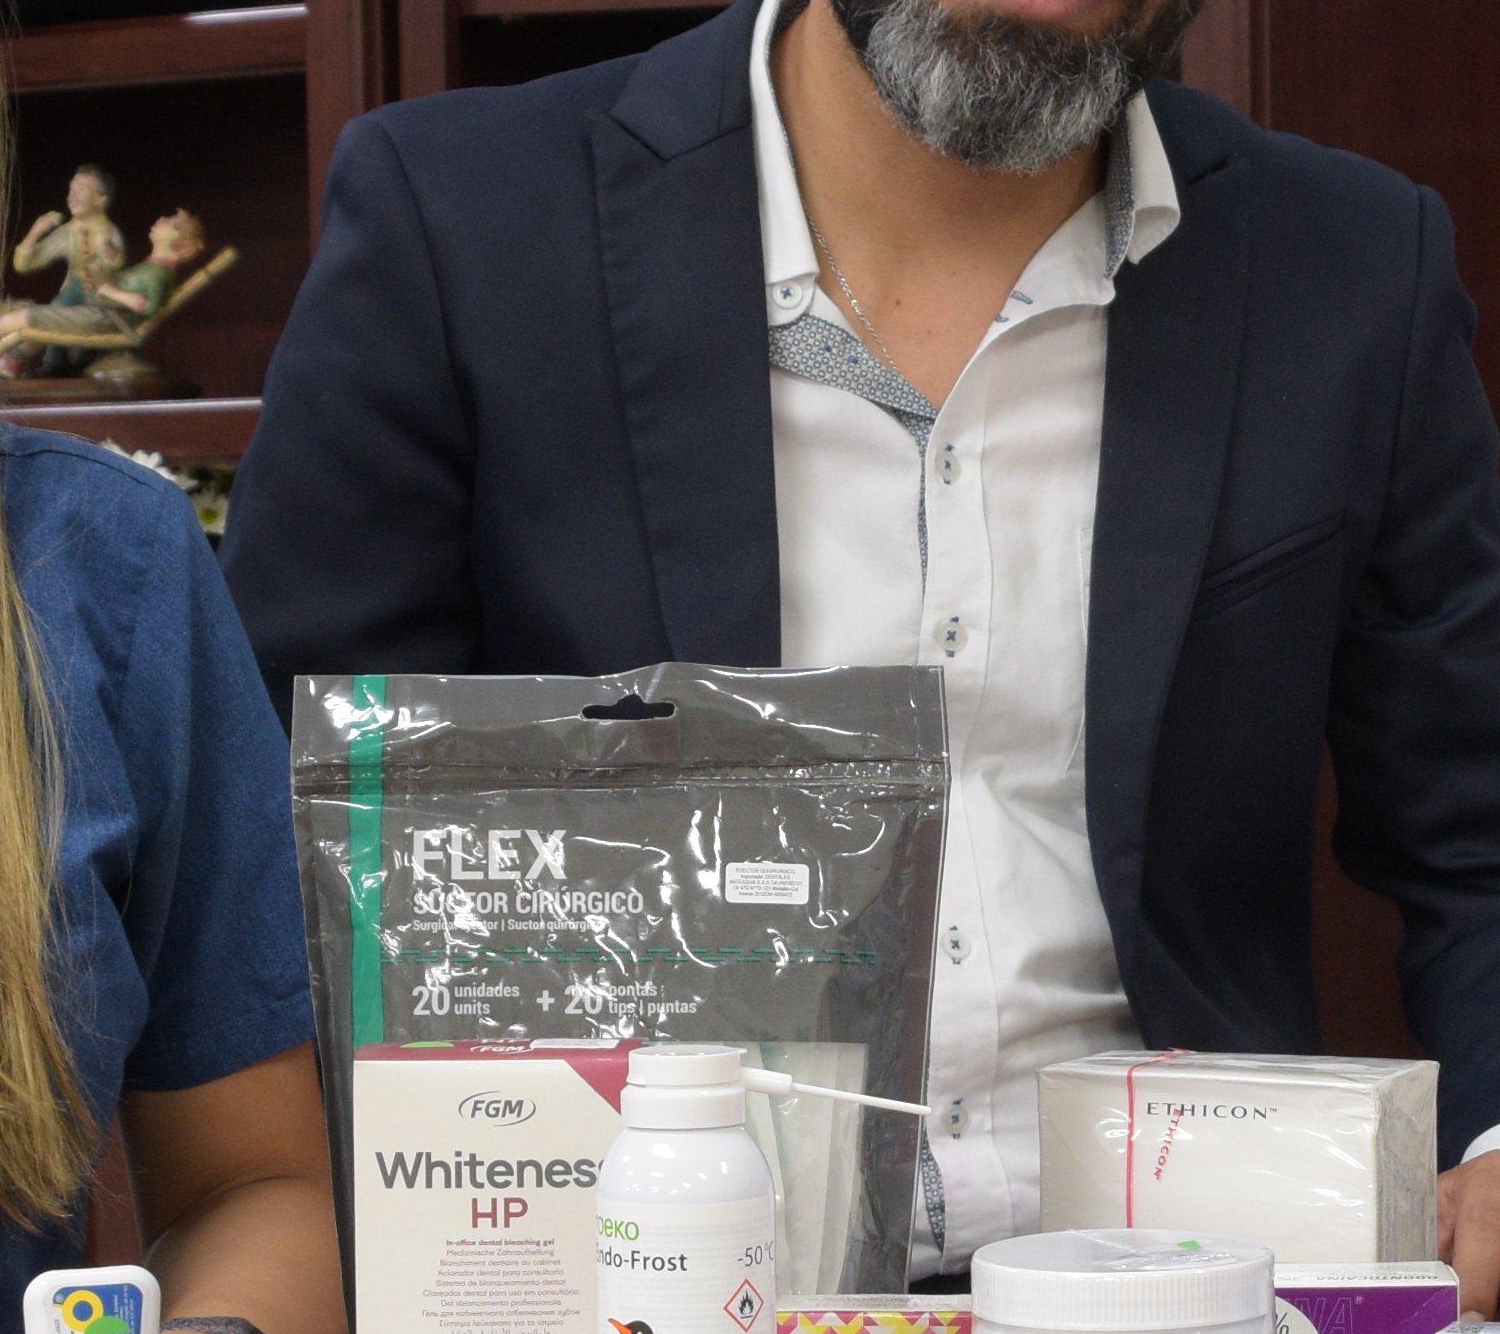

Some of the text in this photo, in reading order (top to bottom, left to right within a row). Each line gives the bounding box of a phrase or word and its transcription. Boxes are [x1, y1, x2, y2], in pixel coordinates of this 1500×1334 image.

[412, 829, 567, 880] FLEX
[413, 892, 508, 914] SUCTOR
[412, 983, 520, 1015] 20 unidades
[454, 1002, 490, 1014] units
[564, 985, 602, 1015] 20
[609, 985, 657, 999] pontas
[609, 1001, 697, 1016] tips puntas
[471, 1099, 524, 1118] FGM
[1153, 1108, 1184, 1181] ETHICON
[375, 1150, 604, 1189] Whitenes
[471, 1197, 528, 1228] HP
